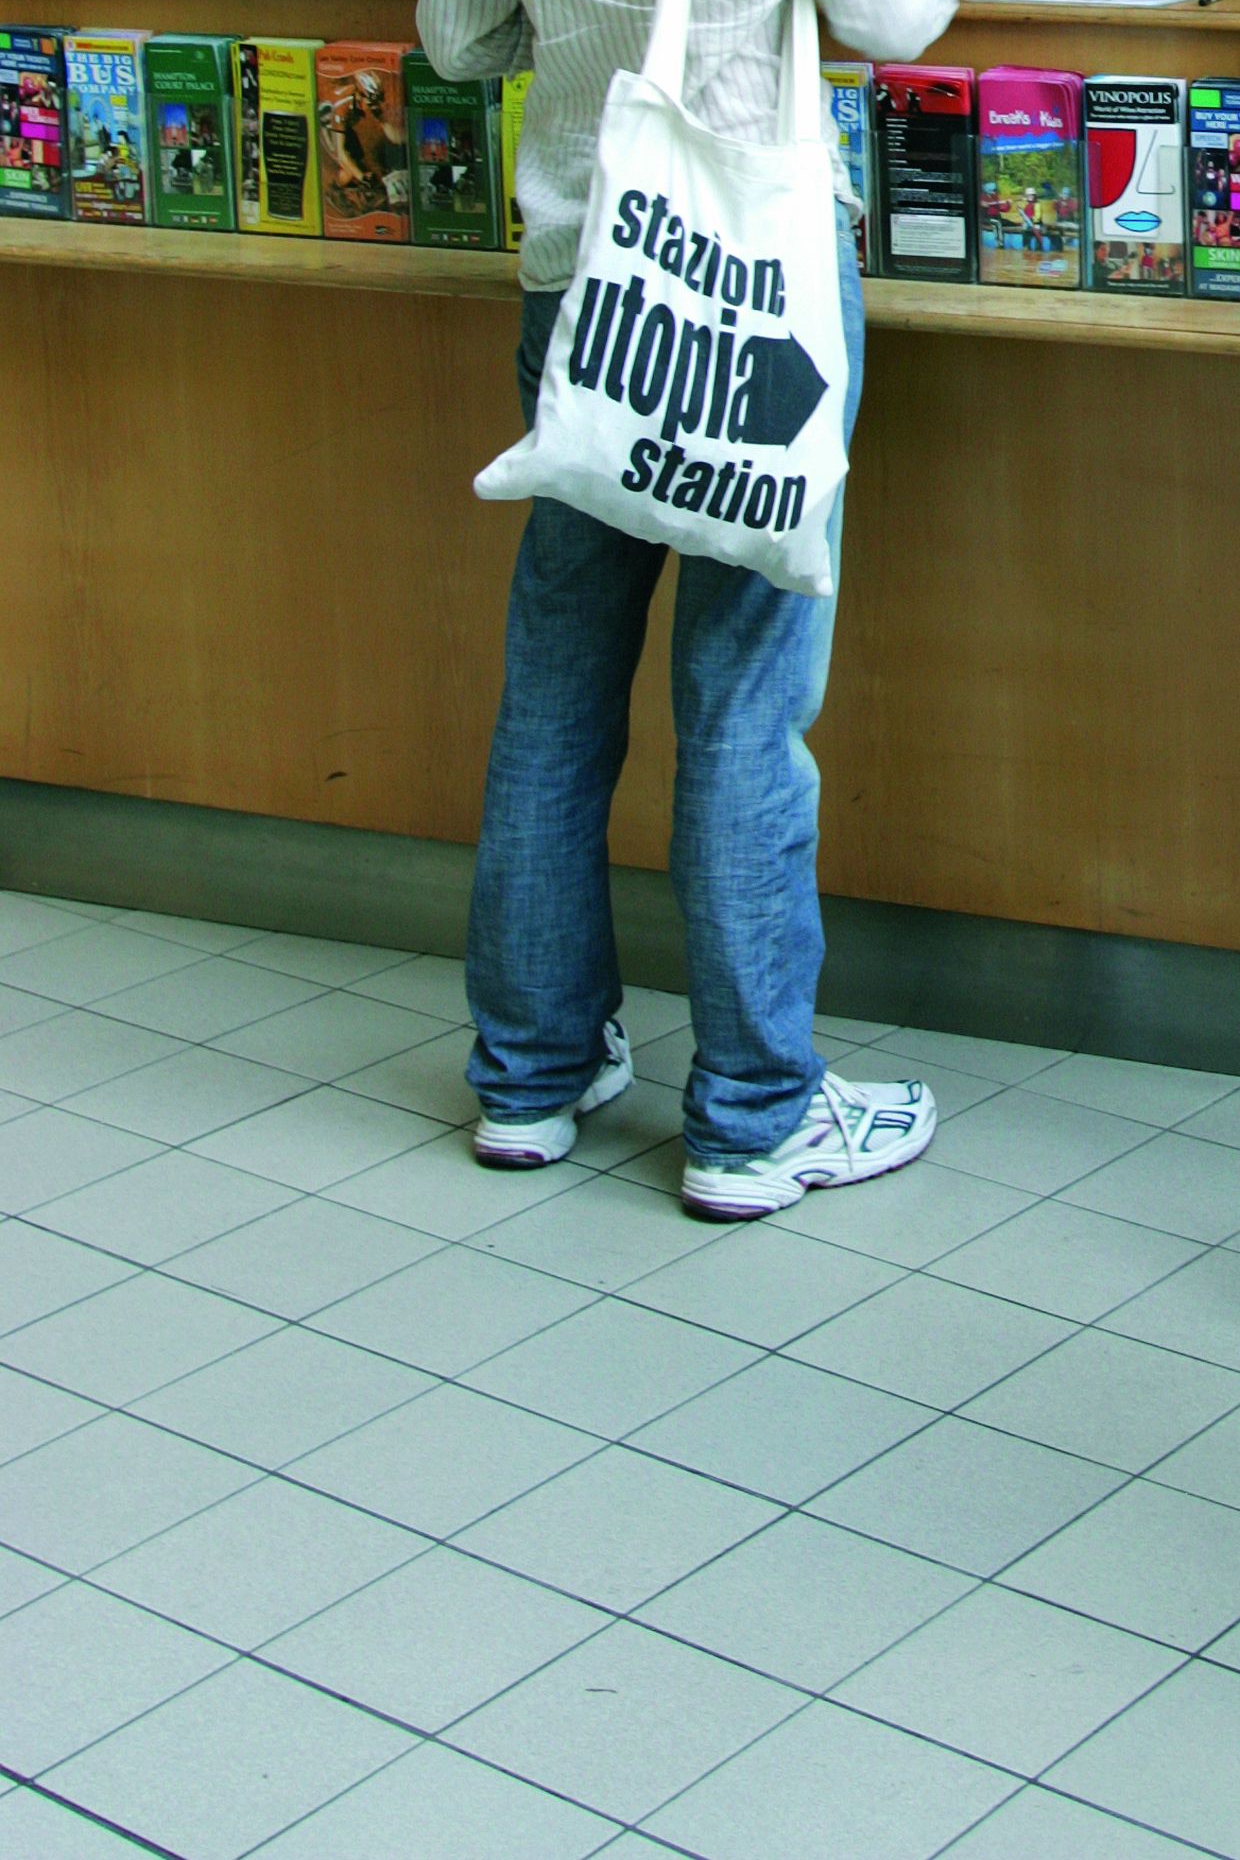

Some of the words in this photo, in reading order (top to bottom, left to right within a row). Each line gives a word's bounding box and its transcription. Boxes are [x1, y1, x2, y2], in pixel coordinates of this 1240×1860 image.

[64, 51, 101, 64] THE
[104, 53, 132, 65] BIG
[67, 62, 136, 87] BUS
[1088, 89, 1172, 105] VINOPOLIS
[1208, 249, 1240, 262] SKIN
[568, 273, 775, 446] utopia
[620, 437, 807, 532] station
